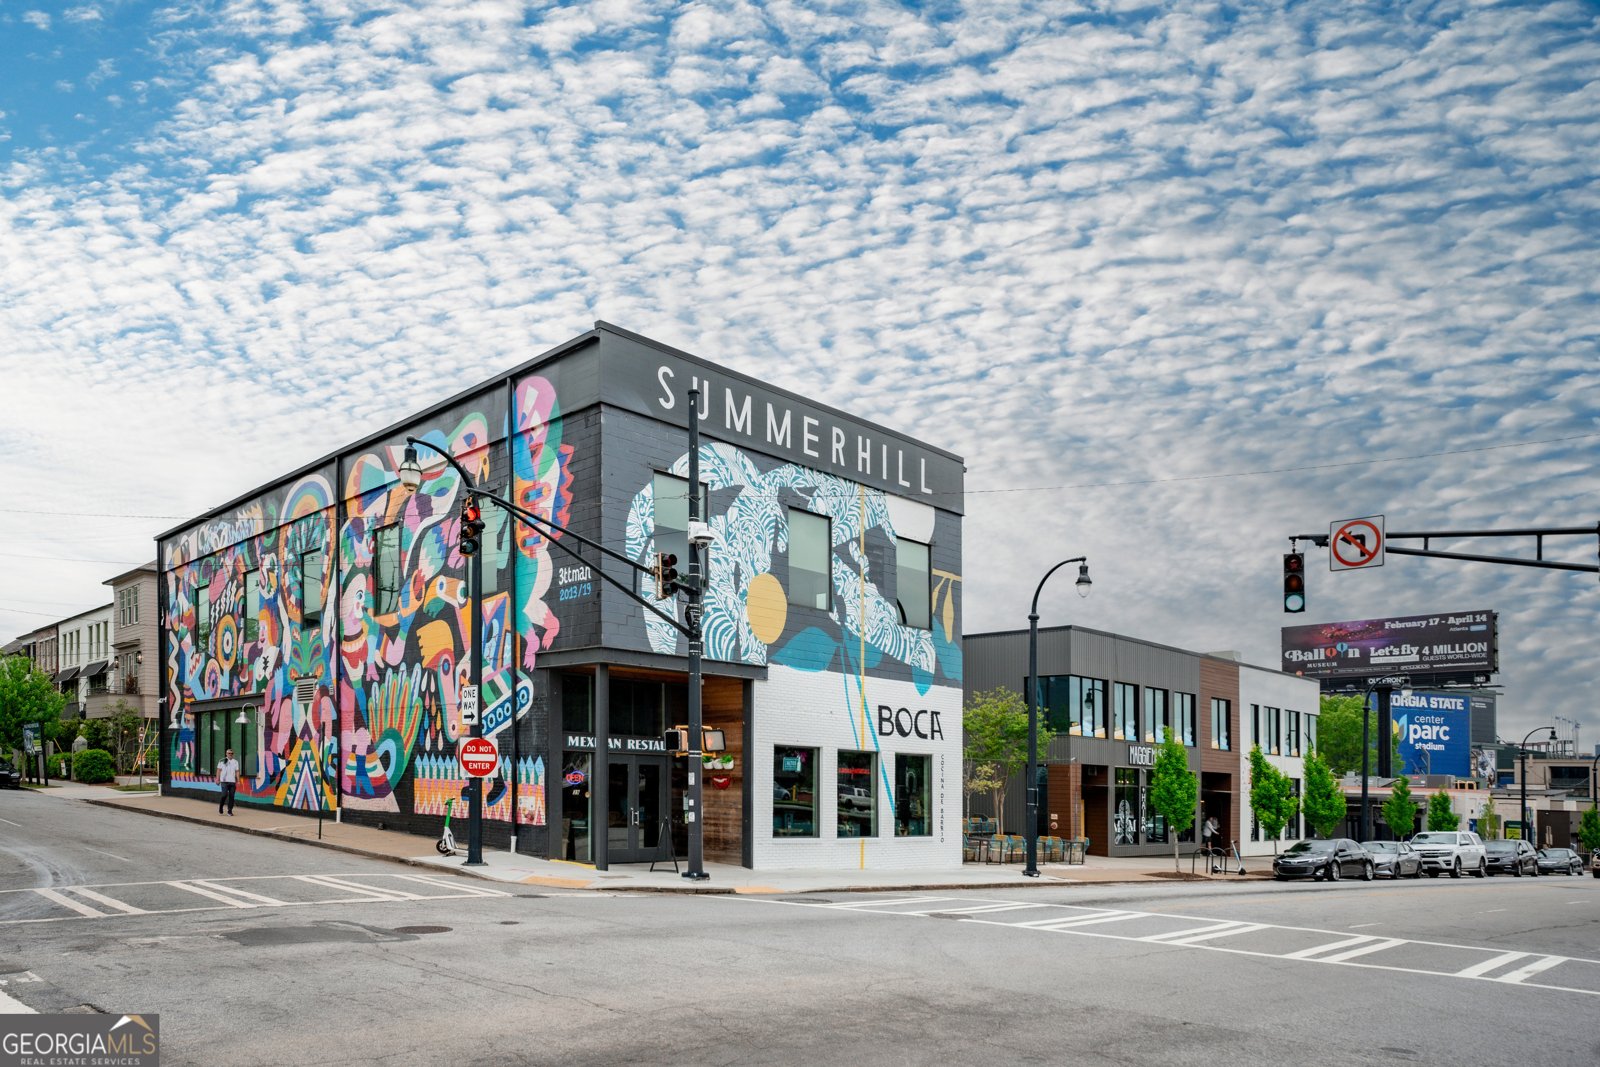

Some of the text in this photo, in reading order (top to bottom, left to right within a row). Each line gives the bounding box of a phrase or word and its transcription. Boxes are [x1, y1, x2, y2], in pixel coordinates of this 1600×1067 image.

[657, 365, 933, 495] SUMMERHILL
[558, 566, 592, 585] 3ttman
[1384, 619, 1428, 630] February
[1429, 617, 1440, 626] 17
[1447, 615, 1473, 626] April
[1475, 614, 1488, 622] 14
[1284, 642, 1361, 662] Balloon
[1369, 644, 1420, 657] Let's fly
[1421, 642, 1488, 655] 4 MILLION
[1422, 654, 1447, 662] GUESTS
[1447, 652, 1488, 660] WORLD-WIDE
[463, 689, 476, 699] ONE
[463, 701, 476, 710] WAY
[1430, 696, 1465, 710] STATE
[877, 705, 944, 741] BOCA
[1414, 715, 1445, 724] center
[1409, 724, 1450, 745] parc
[568, 735, 667, 751] MEXIAN RESTAU
[1415, 741, 1445, 751] stadium
[468, 762, 491, 770] ENTER
[940, 793, 945, 805] DE
